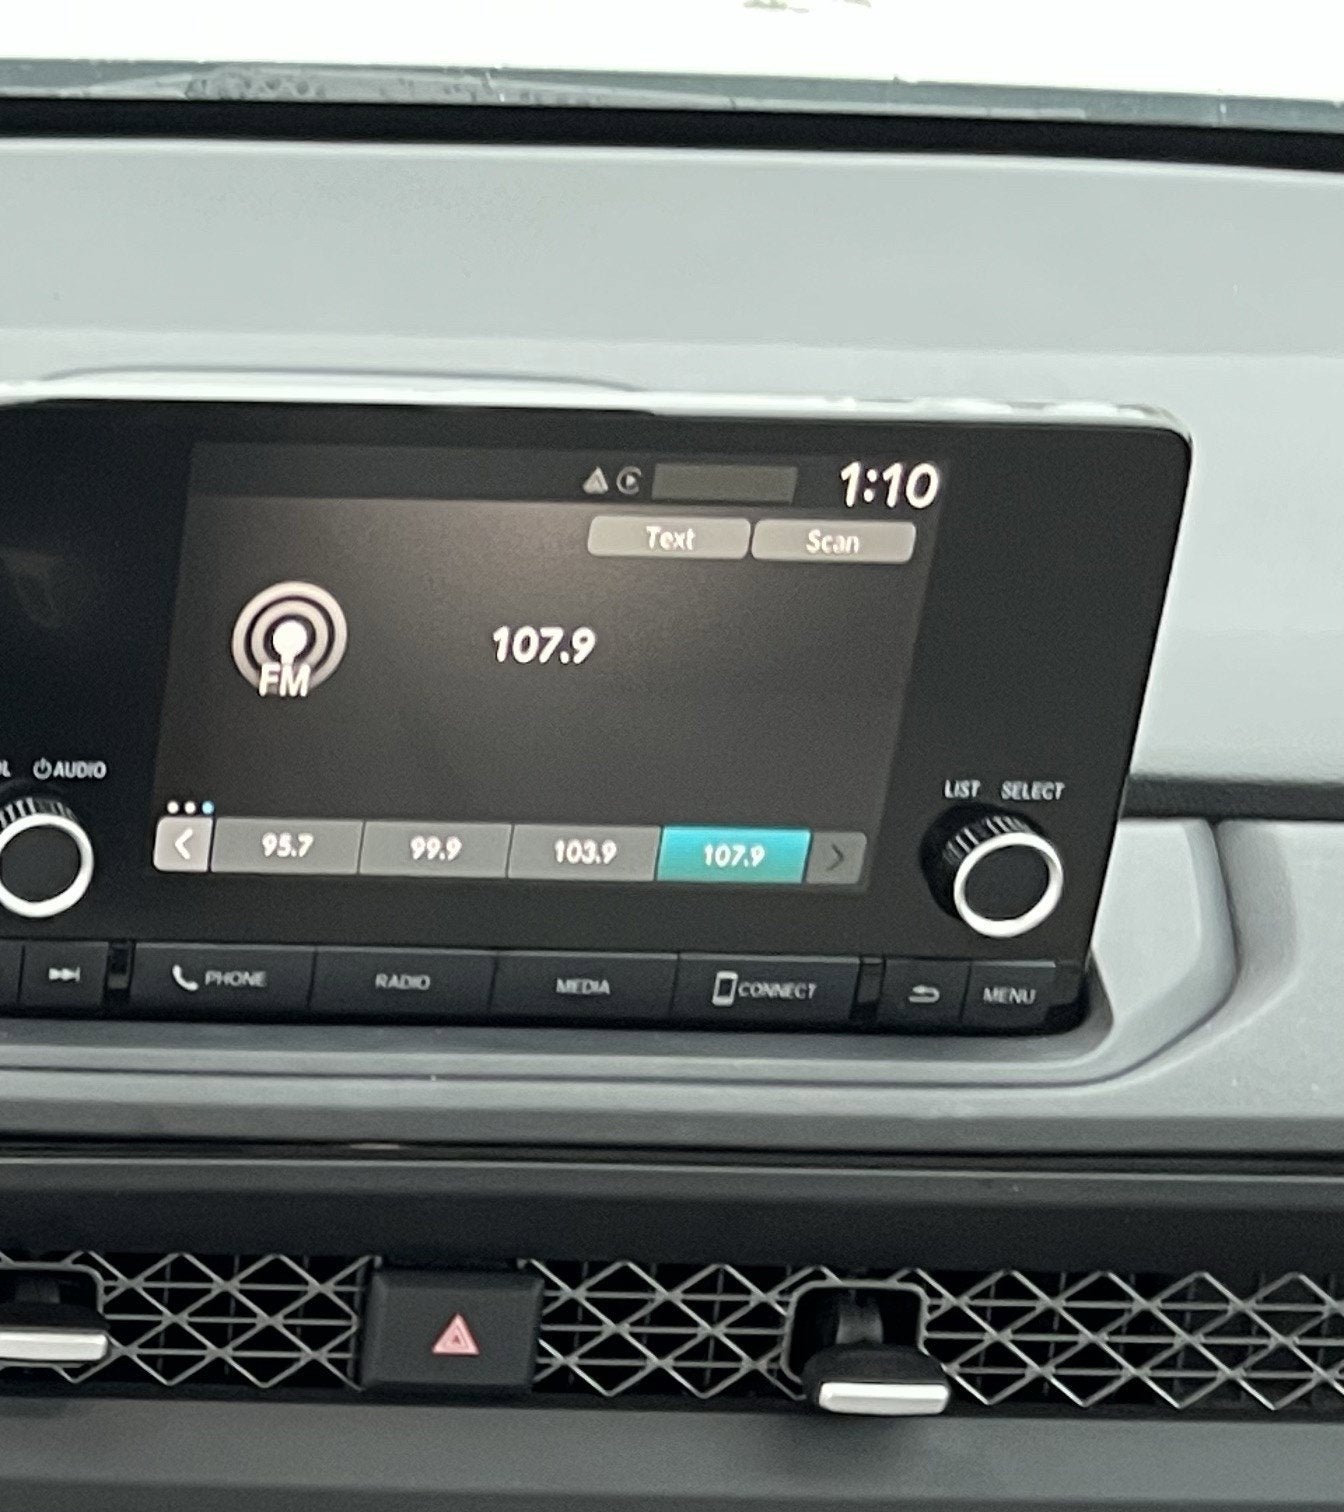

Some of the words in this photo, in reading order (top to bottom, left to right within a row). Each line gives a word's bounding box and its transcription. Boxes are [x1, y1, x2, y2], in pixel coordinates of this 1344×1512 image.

[838, 461, 939, 509] 1:10
[646, 525, 695, 551] Text
[806, 530, 860, 555] Scan
[493, 626, 596, 664] 107.9
[258, 663, 310, 697] FM
[53, 760, 107, 779] AUDIO
[943, 779, 981, 800] LIST
[1000, 780, 1065, 801] SELECT
[261, 833, 315, 860] 95.7
[410, 836, 463, 862] 99.9
[554, 839, 617, 865] 103.9
[702, 844, 766, 868] 107.9
[205, 970, 268, 989] PHONE
[375, 973, 432, 992] RADIO
[556, 976, 611, 996] MEDIA
[738, 978, 817, 1001] CONNECT
[983, 987, 1037, 1005] MENU
